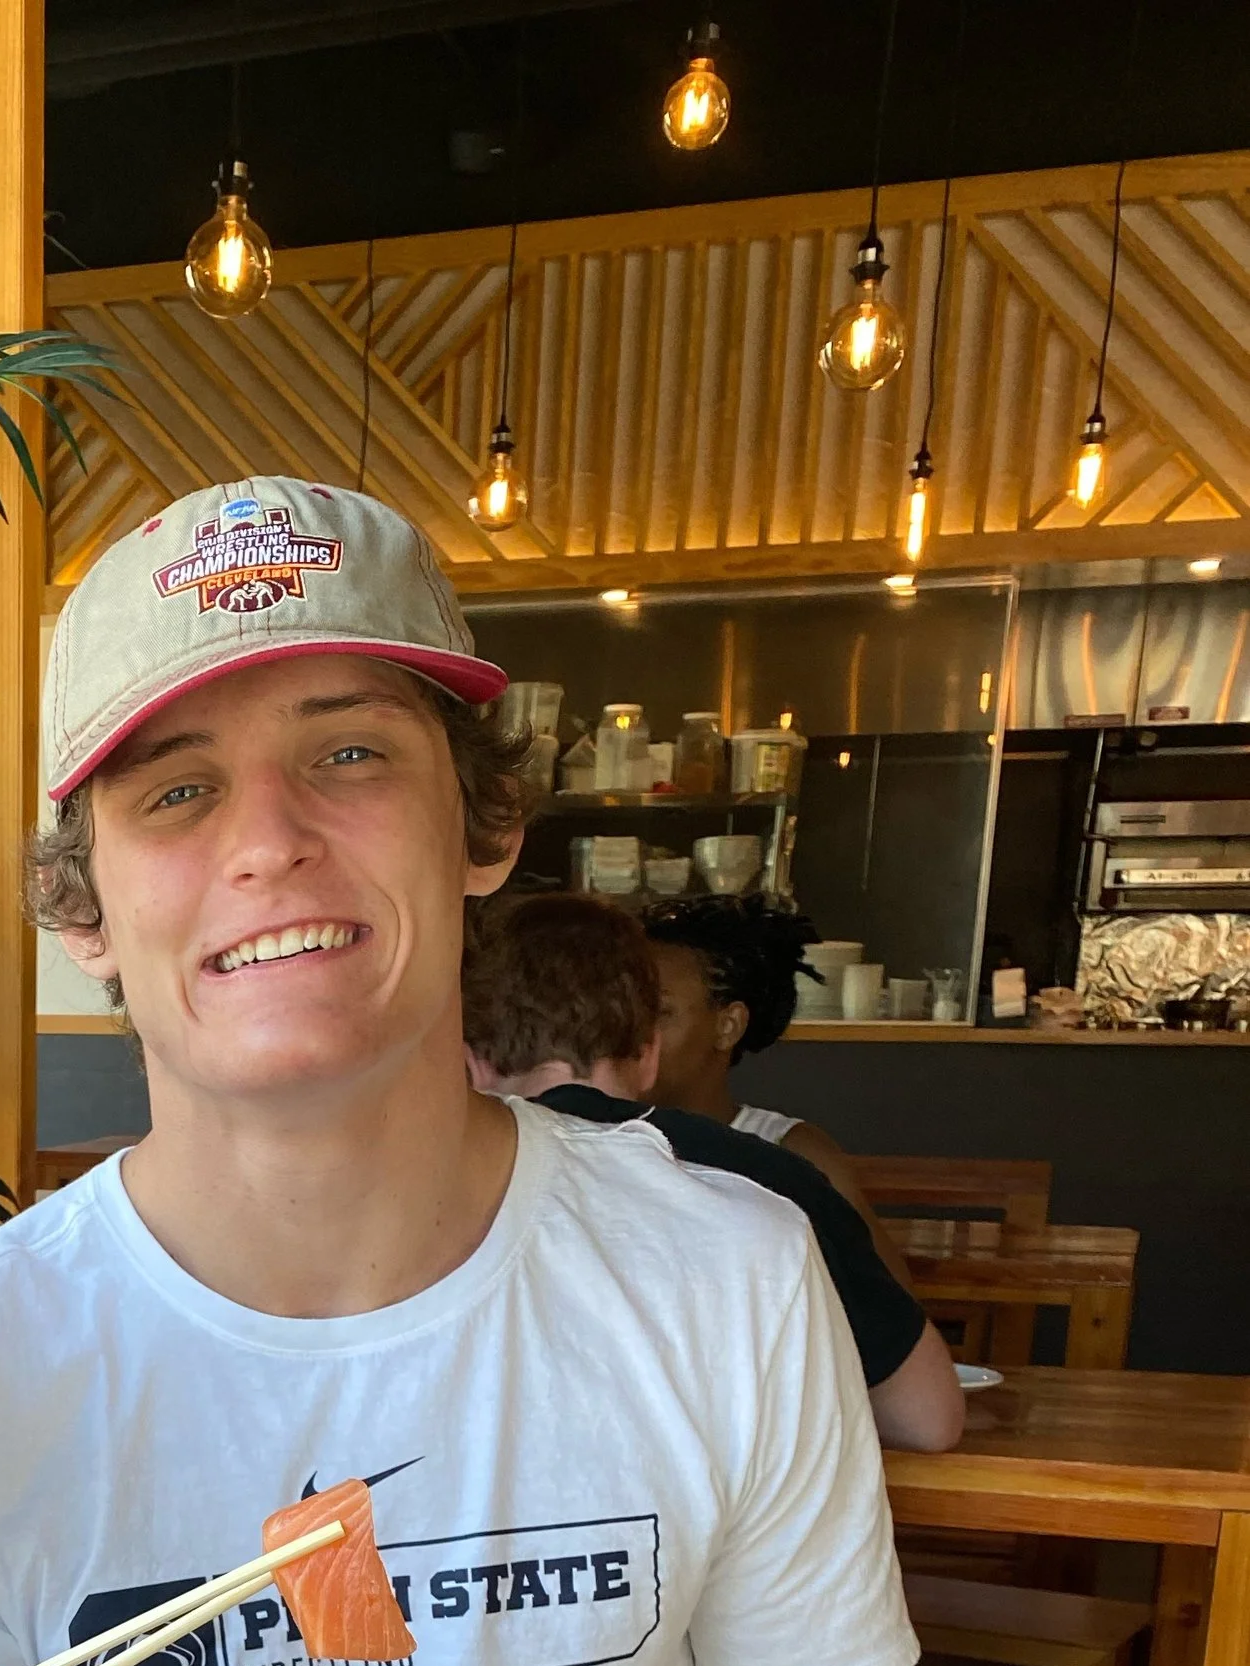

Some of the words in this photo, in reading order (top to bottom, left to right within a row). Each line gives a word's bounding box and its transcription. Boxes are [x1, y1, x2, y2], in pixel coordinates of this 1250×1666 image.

[201, 533, 290, 559] WRESTLING
[226, 525, 282, 541] DIVISION
[167, 544, 332, 590] CHAMPIONSHIPS
[206, 567, 293, 590] CLEVELAND
[430, 1550, 632, 1619] STATE
